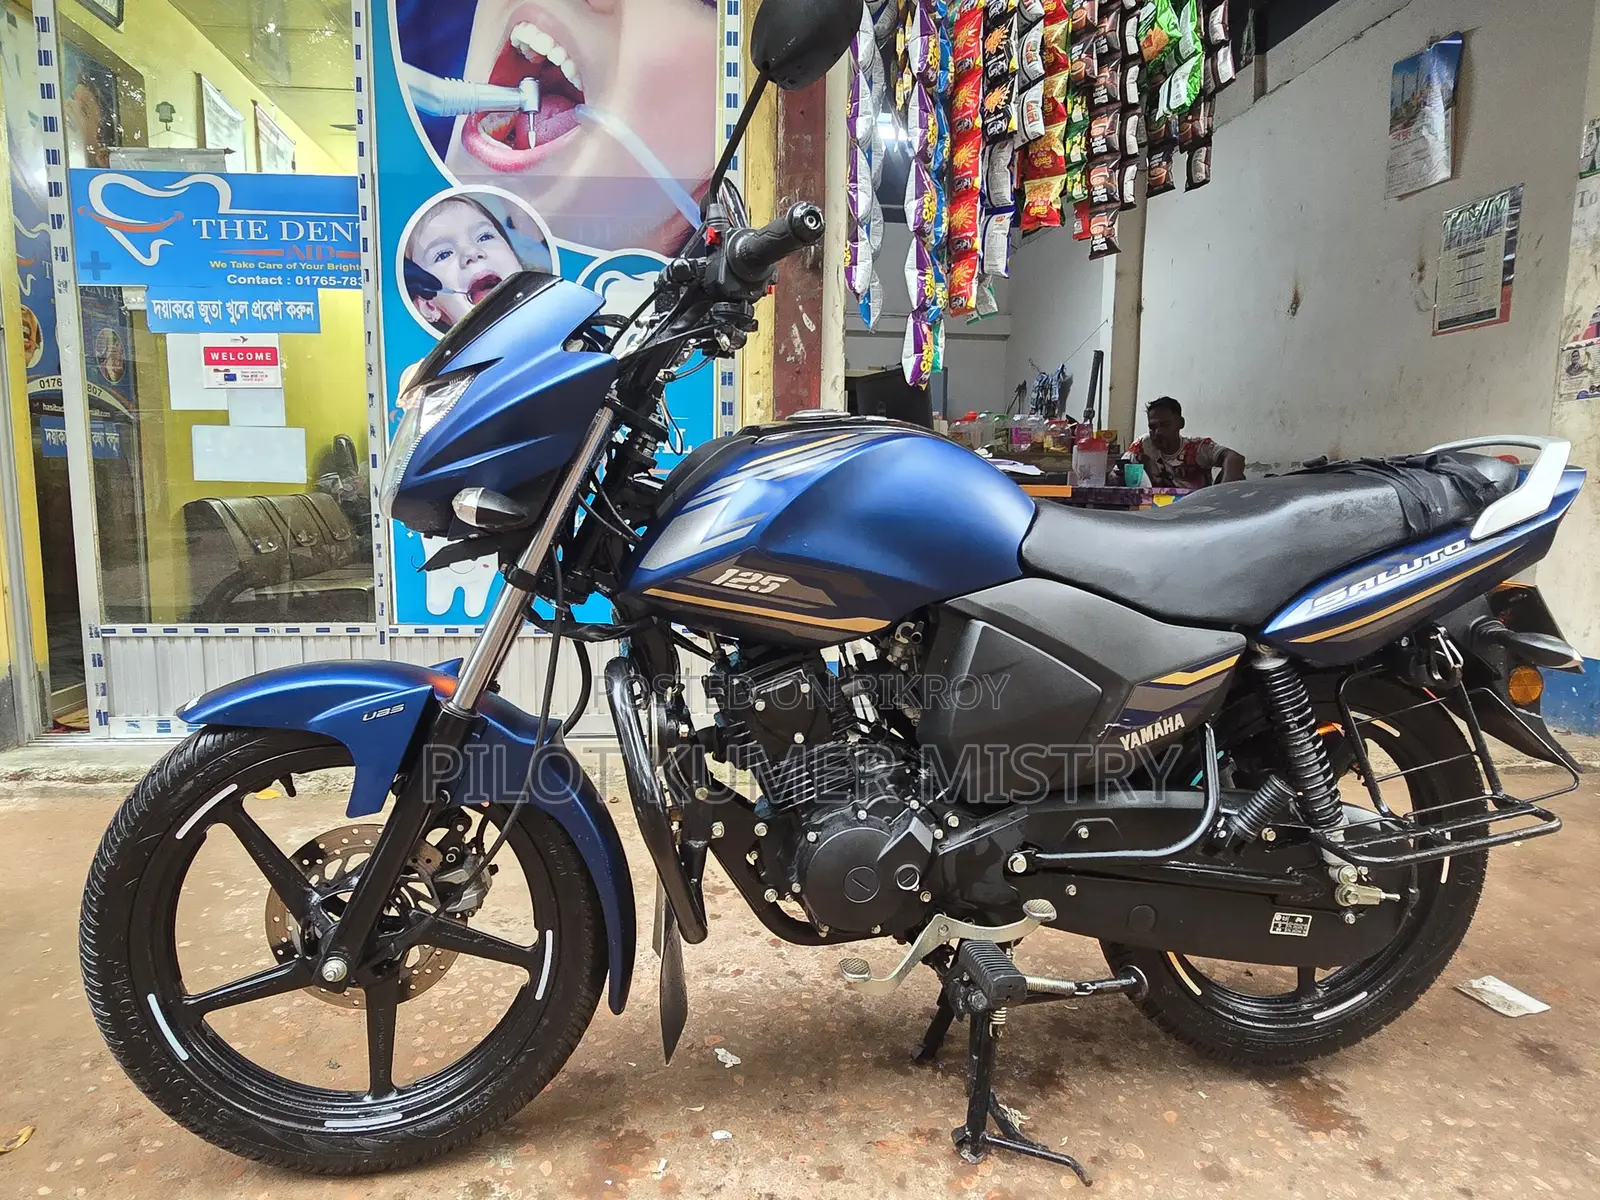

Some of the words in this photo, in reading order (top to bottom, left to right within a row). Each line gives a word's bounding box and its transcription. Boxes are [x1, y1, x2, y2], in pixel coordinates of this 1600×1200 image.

[192, 218, 269, 240] THE
[286, 244, 335, 260] AID
[209, 260, 227, 268] We
[230, 260, 255, 269] Take
[258, 261, 283, 270] Care
[286, 262, 298, 270] of
[327, 263, 361, 272] Bright
[226, 274, 283, 285] Contact
[151, 299, 195, 320] দয়াকরে
[197, 300, 222, 325] জুতা
[225, 299, 249, 325] খুলে
[251, 299, 283, 321] প্রবেশ
[284, 301, 314, 321] করুন
[210, 352, 272, 361] WELCOME
[710, 568, 790, 593] 125
[1311, 538, 1468, 612] SALUTO
[1119, 712, 1186, 751] YAMAHA
